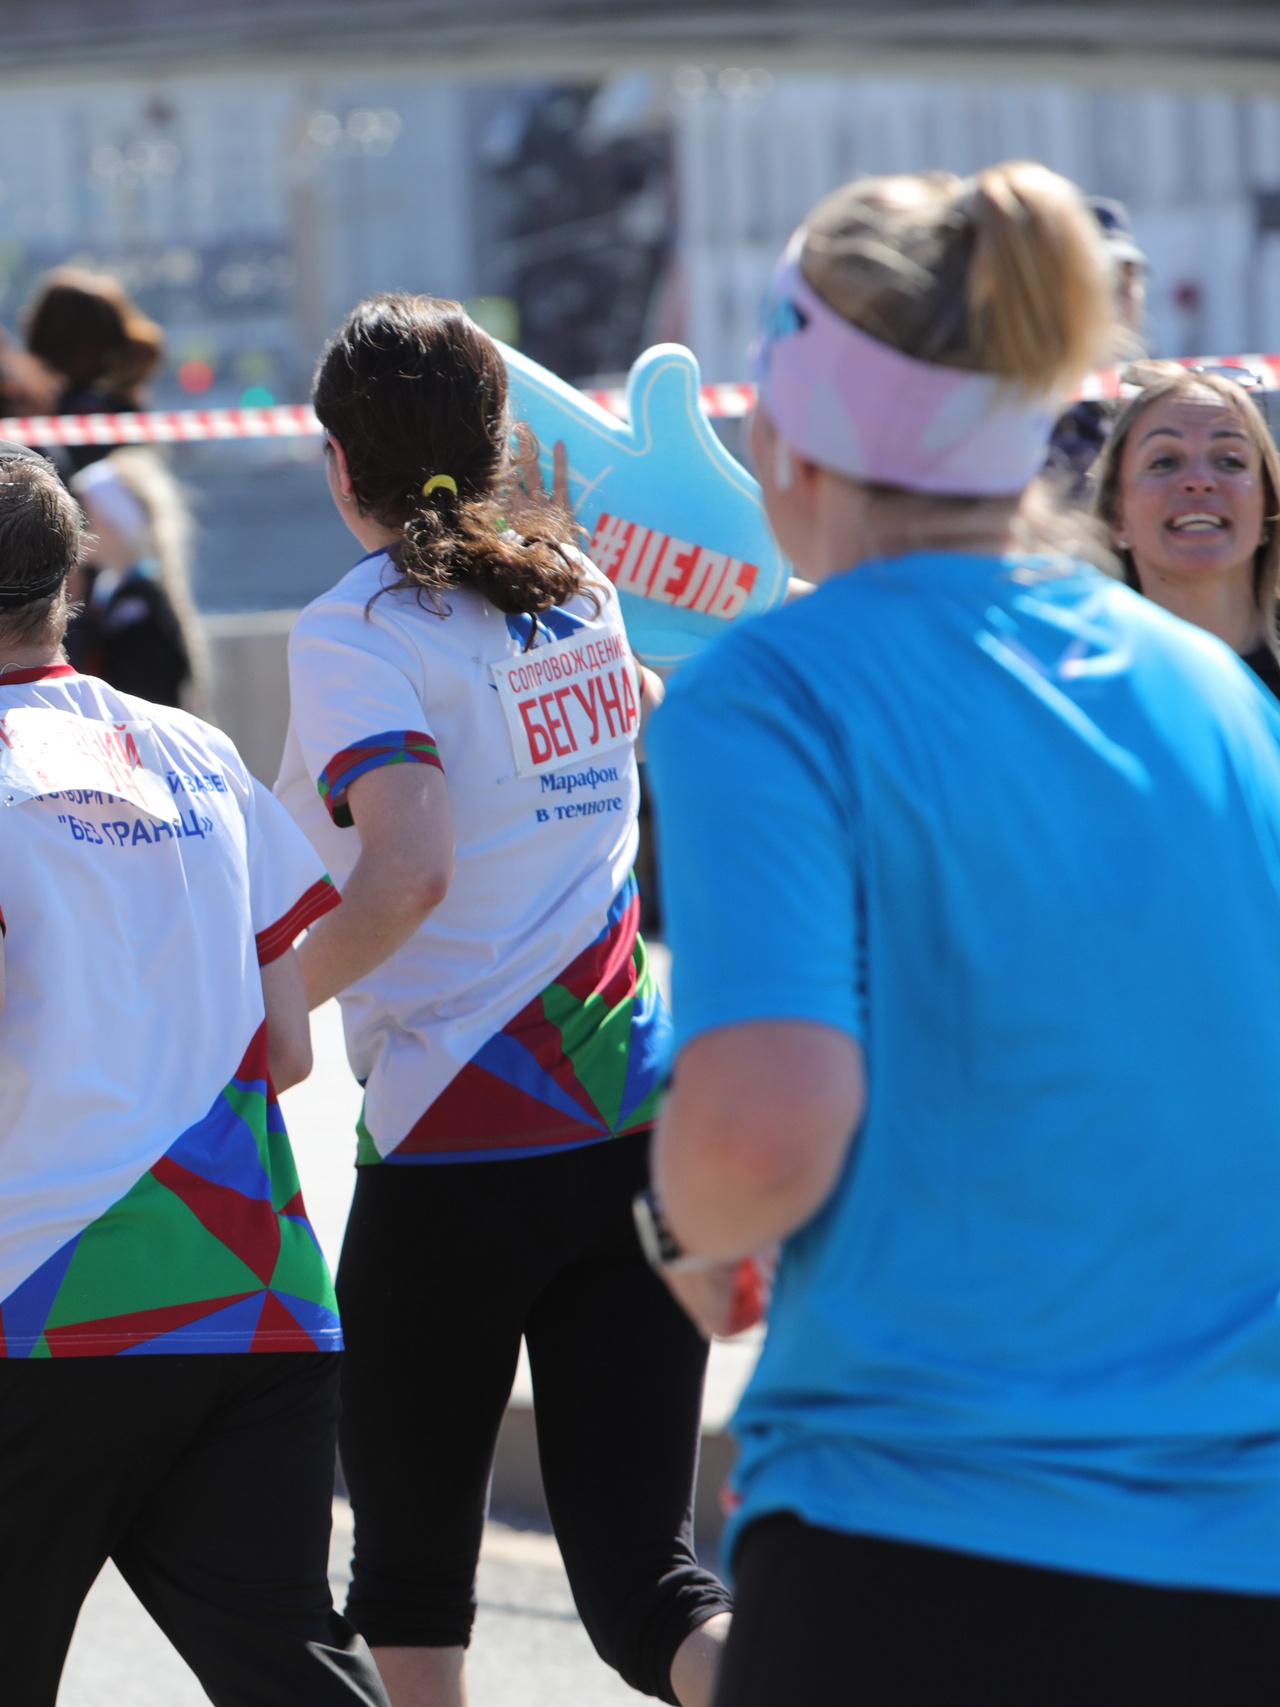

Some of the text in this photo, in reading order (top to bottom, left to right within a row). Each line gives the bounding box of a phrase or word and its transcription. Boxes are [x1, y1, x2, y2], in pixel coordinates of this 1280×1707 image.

[588, 513, 753, 621] #ЦЕЛЬ
[507, 632, 627, 694] СОПРОВОЖДЕНИЕ
[517, 666, 639, 765] БЕГУНА
[535, 796, 624, 823] в темноте
[539, 766, 619, 794] Марафон
